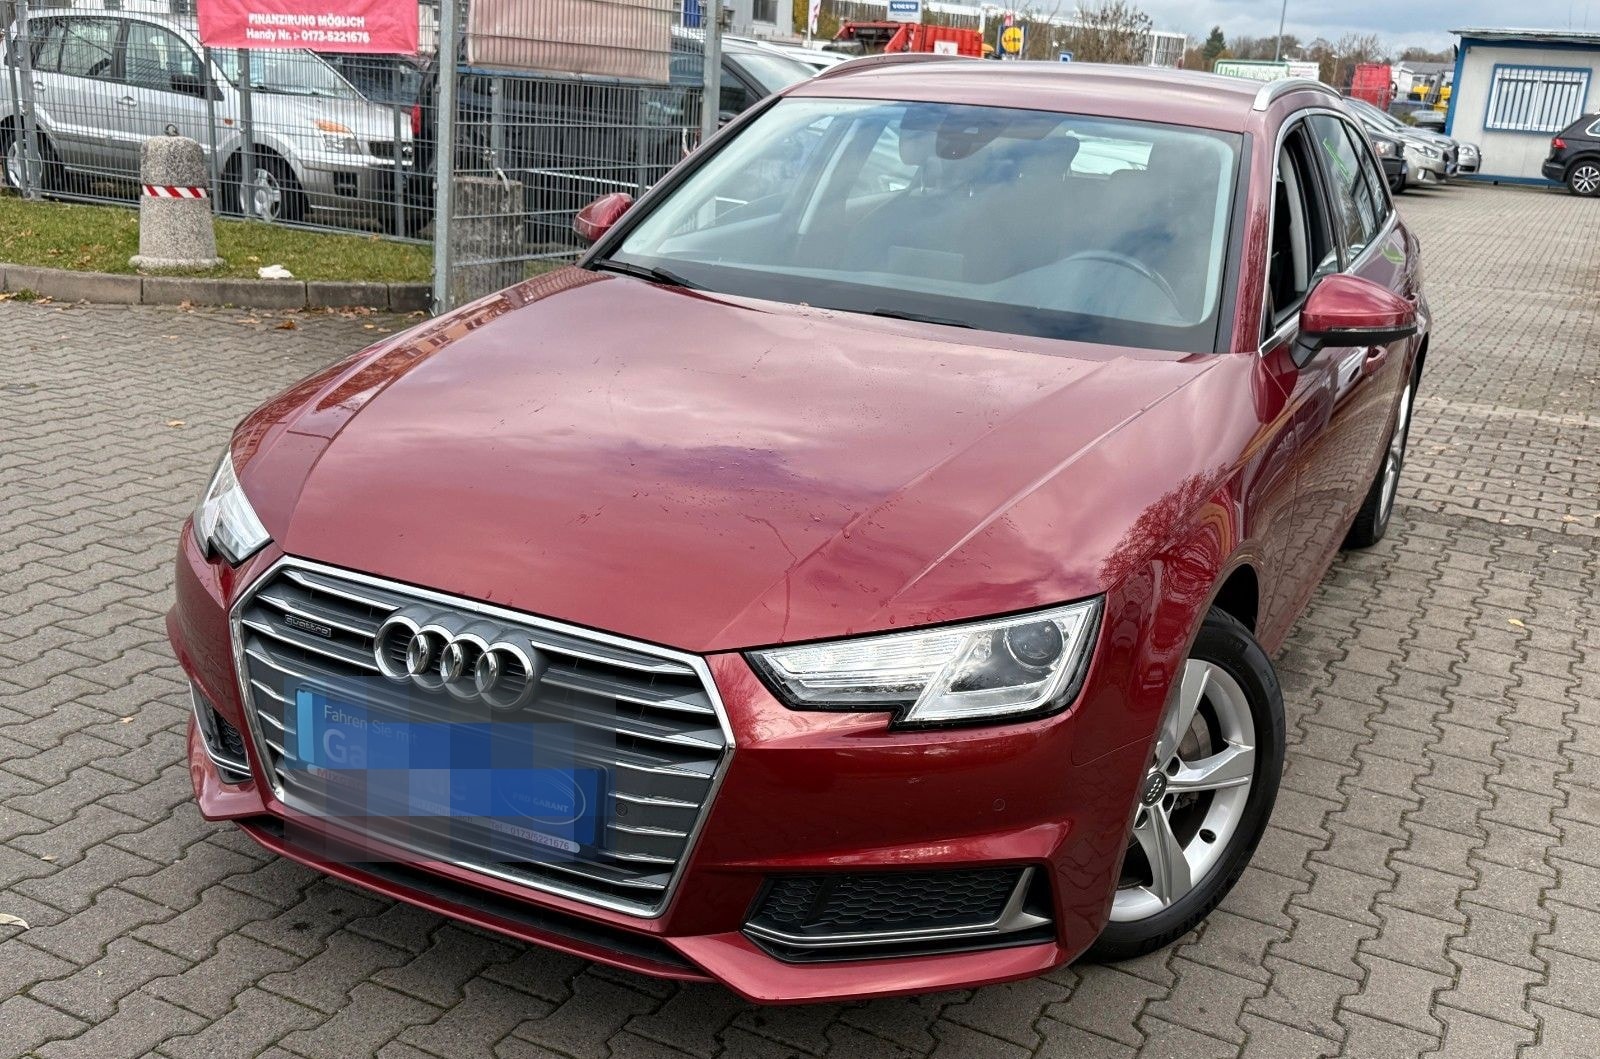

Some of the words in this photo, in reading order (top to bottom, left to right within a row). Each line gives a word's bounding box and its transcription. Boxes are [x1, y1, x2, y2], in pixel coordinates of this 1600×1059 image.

[248, 13, 316, 26] FINANZIRUNG
[317, 14, 365, 28] MÖGLICH
[246, 28, 276, 42] Handy
[285, 616, 329, 635] quattro
[324, 704, 368, 730] Fahren
[371, 719, 393, 738] Sie
[532, 796, 569, 813] GARANT
[510, 827, 569, 850] 0173/5221676
